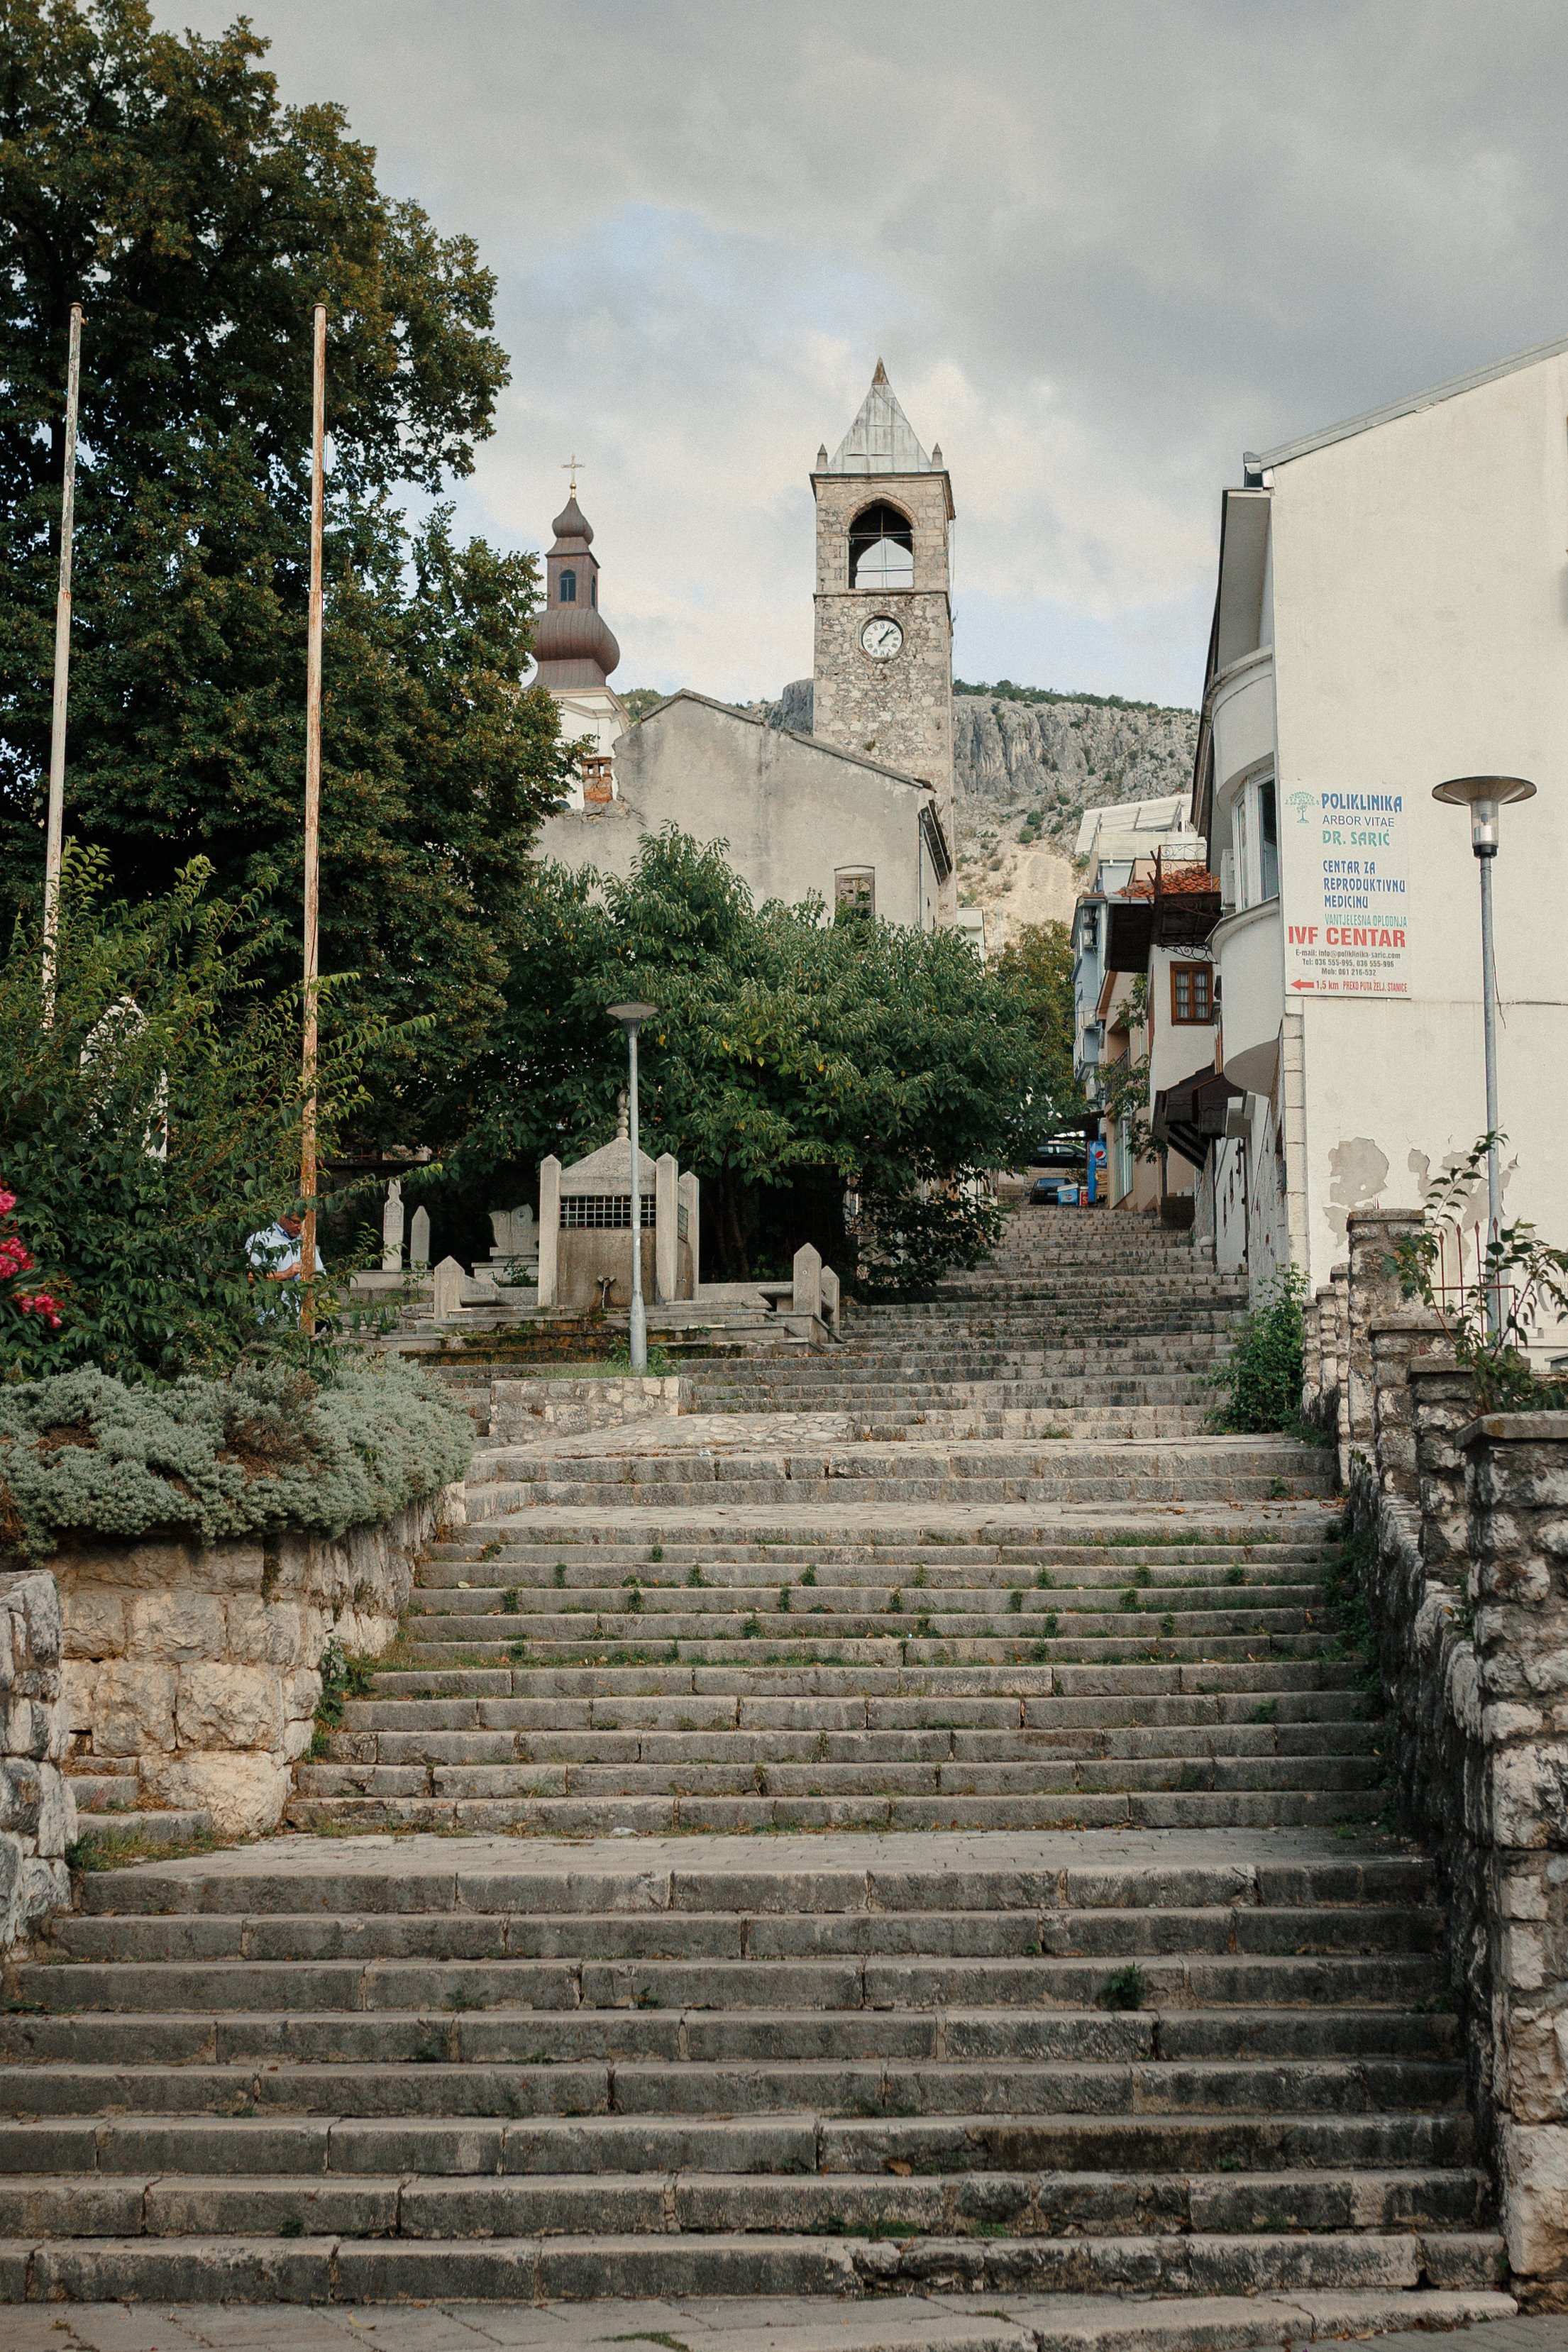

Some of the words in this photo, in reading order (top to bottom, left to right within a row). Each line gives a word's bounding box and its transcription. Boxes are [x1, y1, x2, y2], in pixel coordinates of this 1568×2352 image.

[1321, 793, 1403, 813] POLIKLINIKA
[1323, 815, 1361, 826] ARBOR
[1364, 817, 1395, 827] VITAE
[1323, 830, 1346, 846] DR.
[1350, 829, 1390, 847] SARIĆ
[1323, 860, 1360, 875] CENTAR
[1364, 861, 1376, 876] ZA
[1323, 877, 1406, 893] REPRODUKTIVNU
[1324, 895, 1369, 908] MEDICINU
[1325, 914, 1371, 927] VANTJELESNA
[1373, 915, 1407, 927] OPLODNJA
[1288, 926, 1318, 944] IVF
[1326, 927, 1406, 947] CENTAR
[1318, 949, 1401, 959] info@poliklinika-saric.com
[1316, 981, 1326, 990] 1,5
[1328, 981, 1339, 990] km
[1343, 981, 1359, 991] PREKO
[1360, 982, 1372, 991] PUTA
[1388, 983, 1408, 993] STANICE
